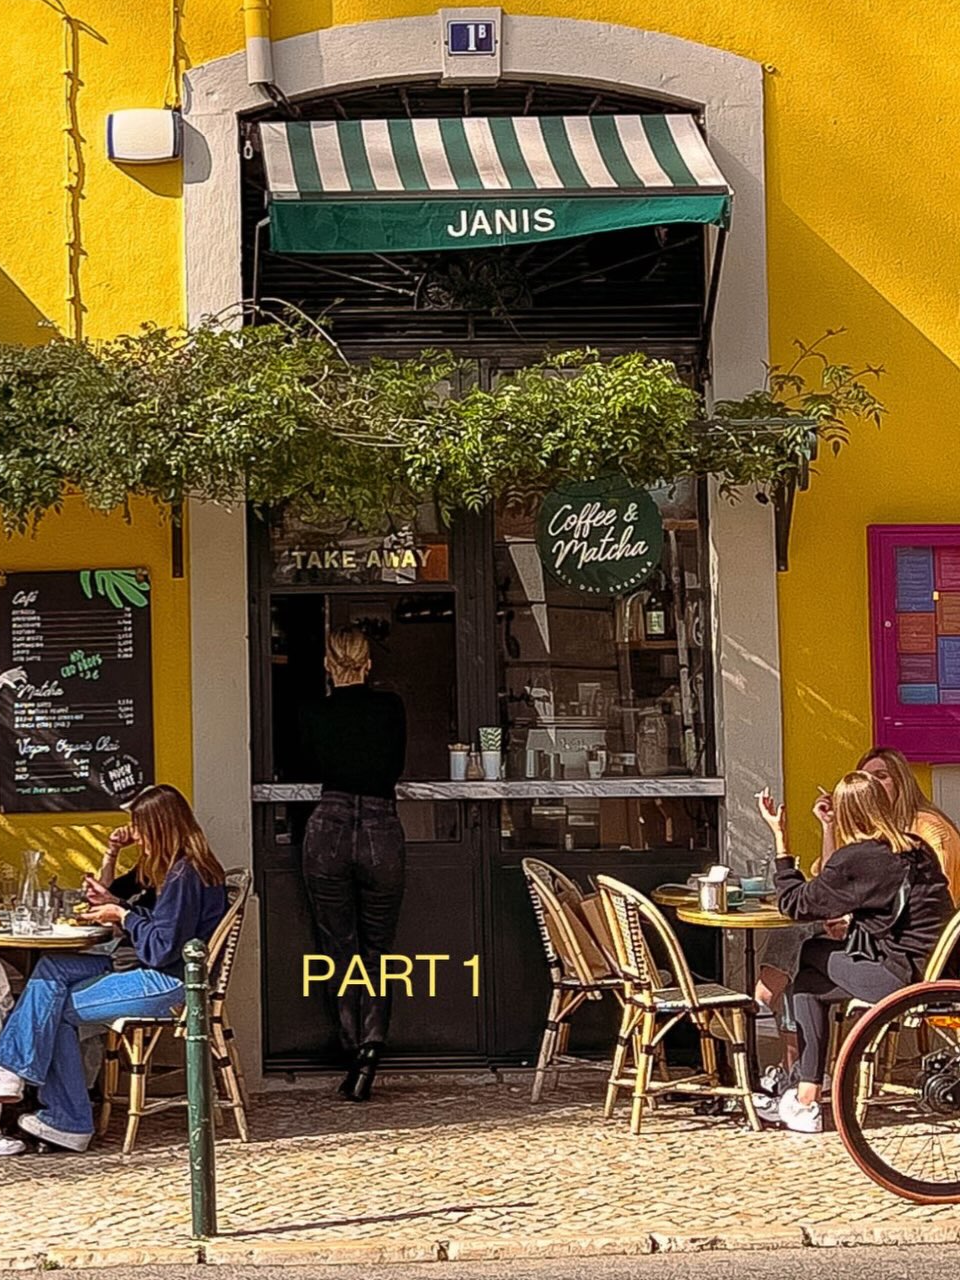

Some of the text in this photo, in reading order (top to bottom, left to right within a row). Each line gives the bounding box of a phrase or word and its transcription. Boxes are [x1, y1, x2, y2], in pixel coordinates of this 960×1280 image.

[446, 208, 556, 238] JANIS
[548, 502, 639, 539] Coffee &
[551, 525, 649, 570] Matcha
[291, 549, 432, 570] TAKE AWAY
[12, 590, 39, 607] Café
[16, 737, 51, 759] Vegan
[112, 774, 136, 792] MORE
